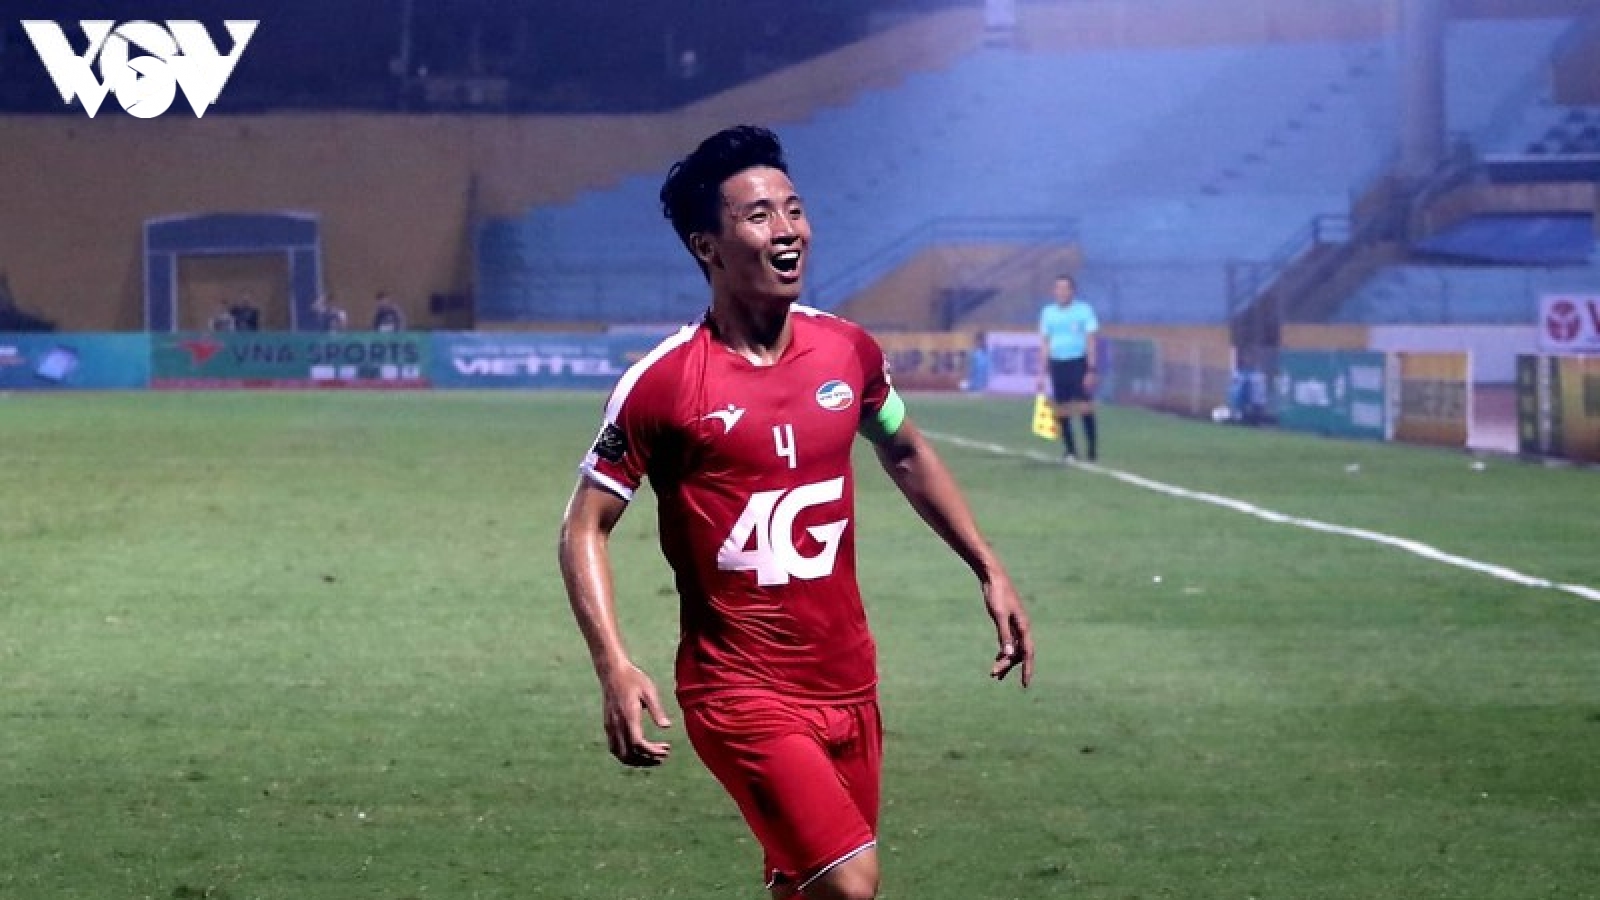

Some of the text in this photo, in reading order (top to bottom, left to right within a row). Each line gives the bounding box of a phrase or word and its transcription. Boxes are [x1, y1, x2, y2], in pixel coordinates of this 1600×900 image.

[232, 339, 420, 363] VNA SPORTS
[772, 423, 797, 469] 4
[717, 476, 849, 586] 4G
